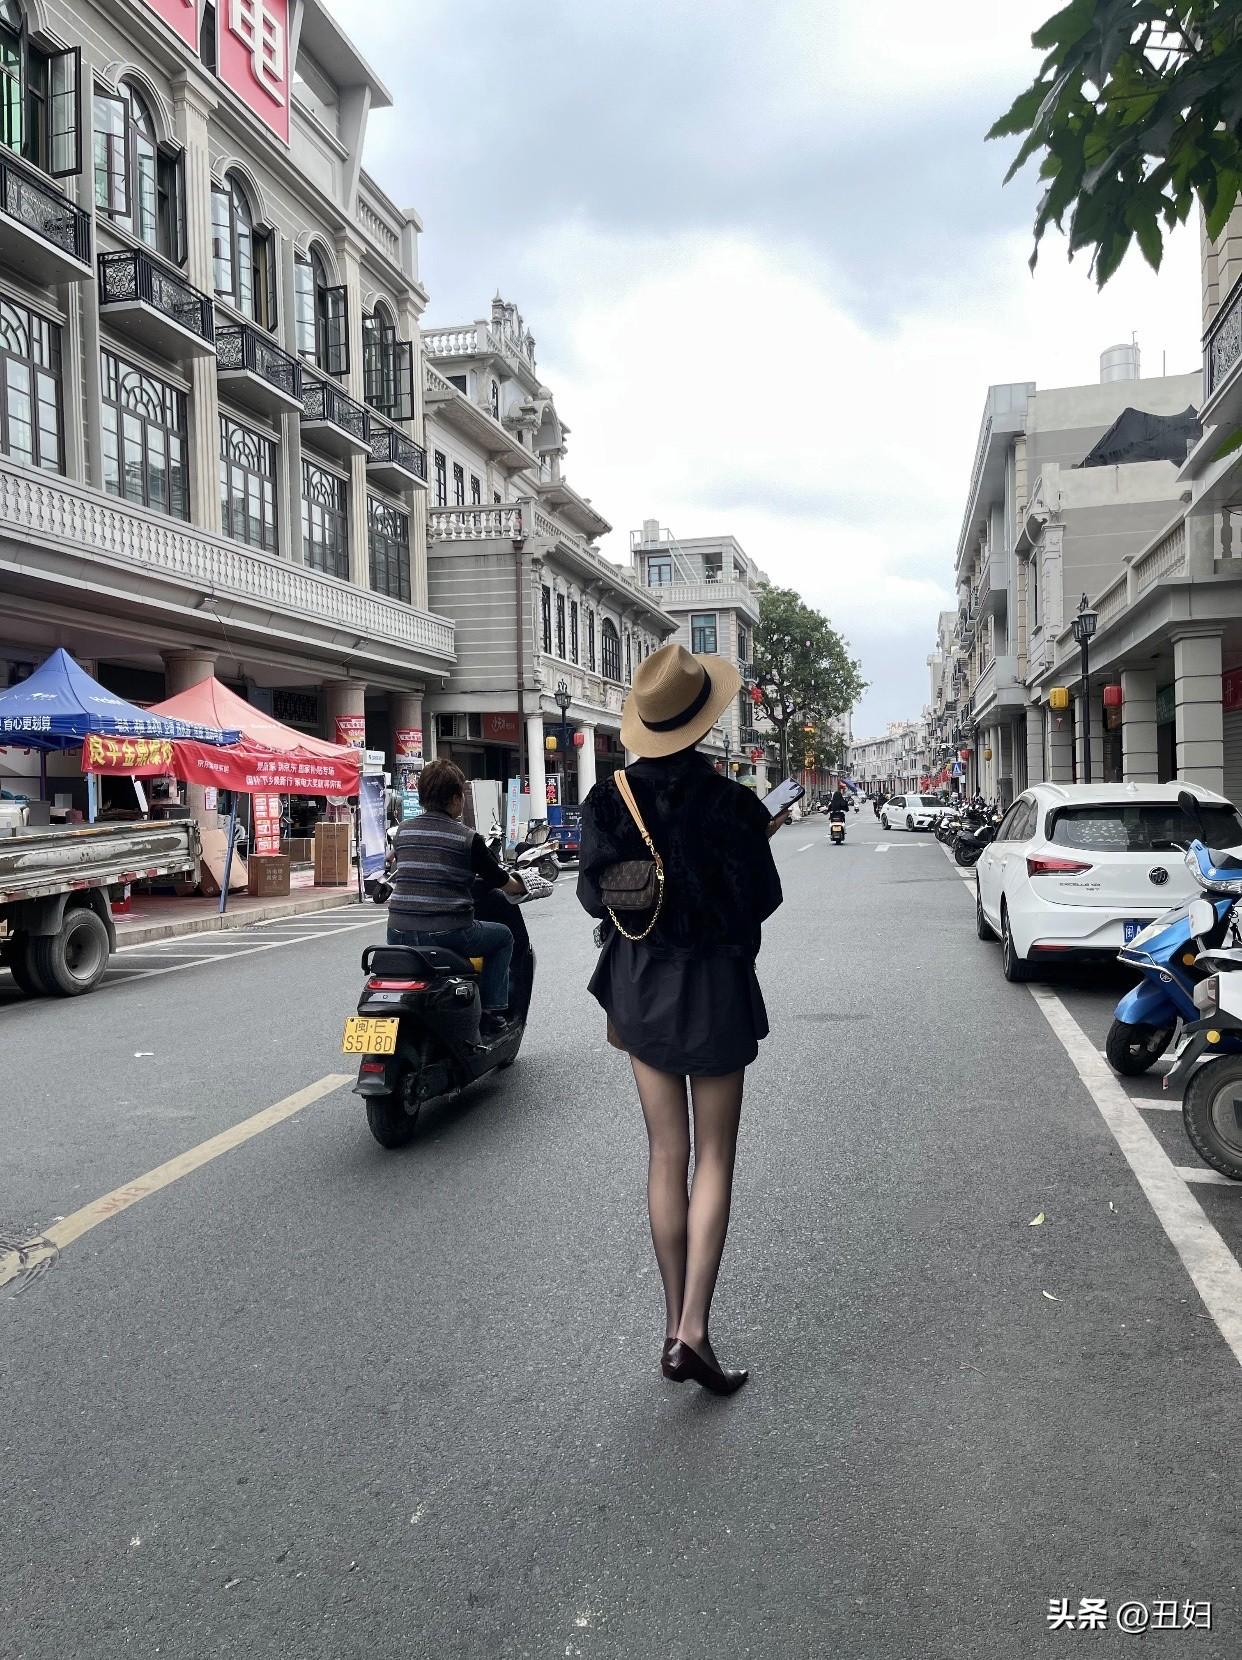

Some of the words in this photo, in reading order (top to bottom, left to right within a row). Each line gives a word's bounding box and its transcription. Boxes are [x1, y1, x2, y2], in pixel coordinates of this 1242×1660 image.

[3, 716, 51, 731] 省心更划算
[345, 1035, 393, 1052] S518D
